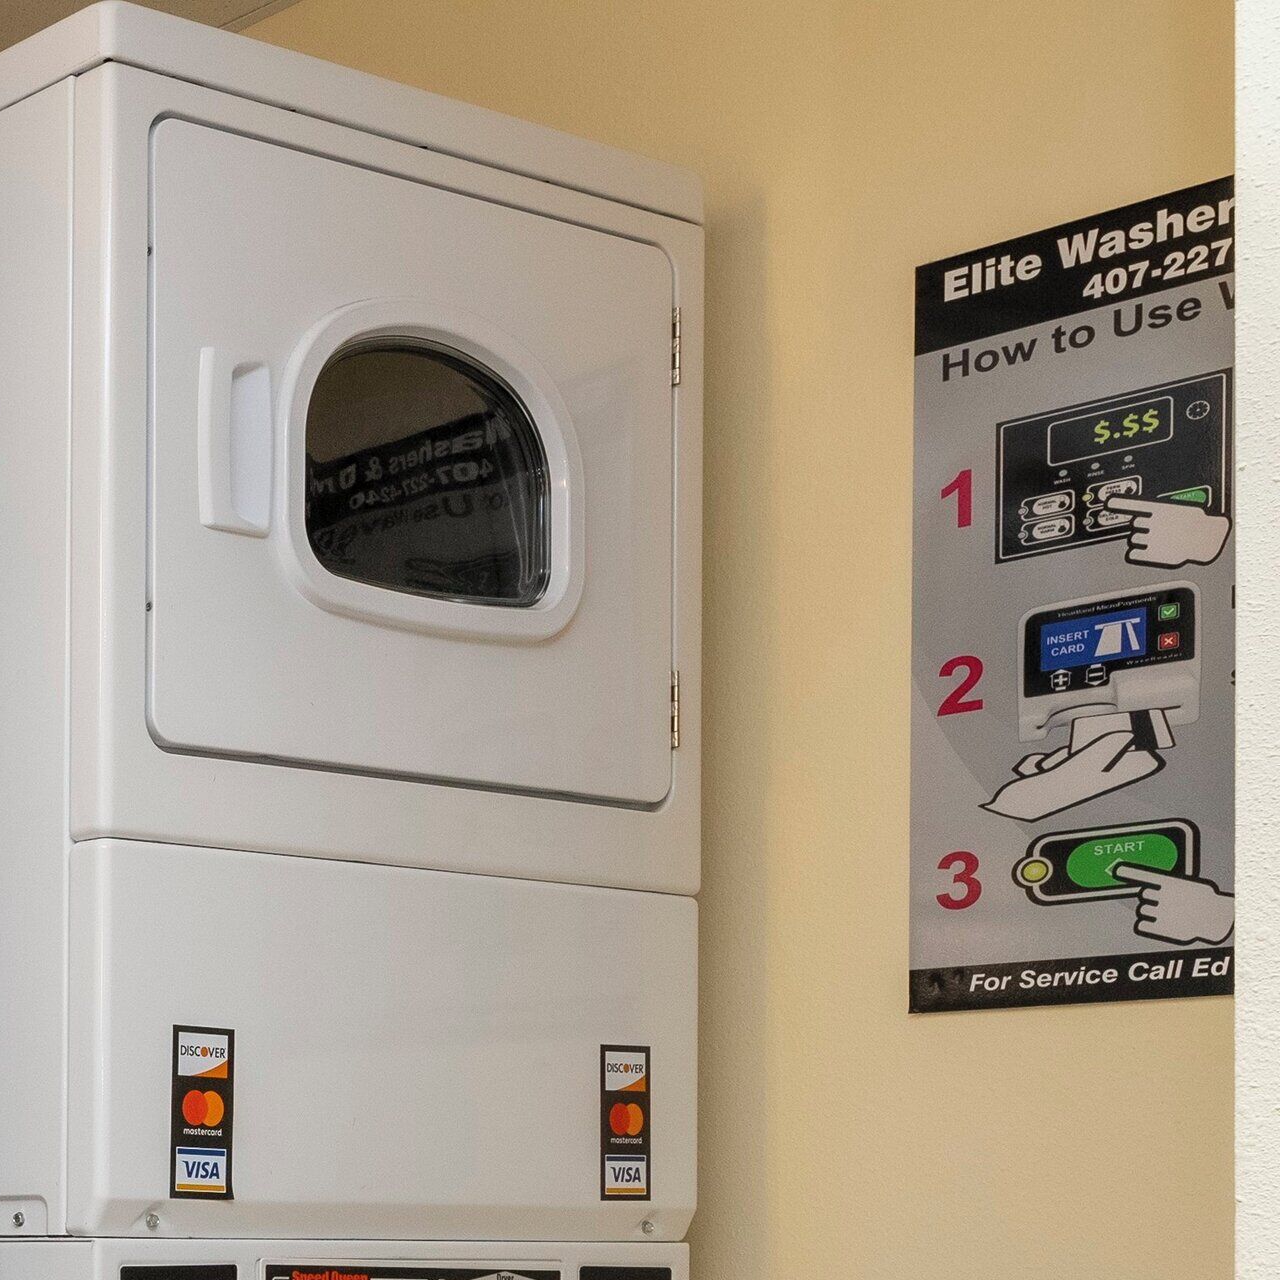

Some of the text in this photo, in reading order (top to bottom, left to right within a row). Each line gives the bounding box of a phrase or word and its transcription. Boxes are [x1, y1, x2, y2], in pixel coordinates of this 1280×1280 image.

[1082, 237, 1233, 299] 407-227
[944, 253, 1042, 302] Elite
[942, 296, 1202, 382] How to Use
[941, 469, 972, 528] 1
[1047, 630, 1089, 645] INSERT
[1051, 643, 1084, 657] CARD
[937, 655, 984, 717] 2
[1094, 840, 1145, 856] START
[936, 851, 983, 910] 3
[970, 957, 1230, 992] For Service Call Ed
[180, 1045, 226, 1058] DISCOVER
[607, 1063, 643, 1073] DISCOVER
[183, 1128, 222, 1136] mastercard
[182, 1161, 220, 1179] VISA
[611, 1166, 641, 1183] VISA
